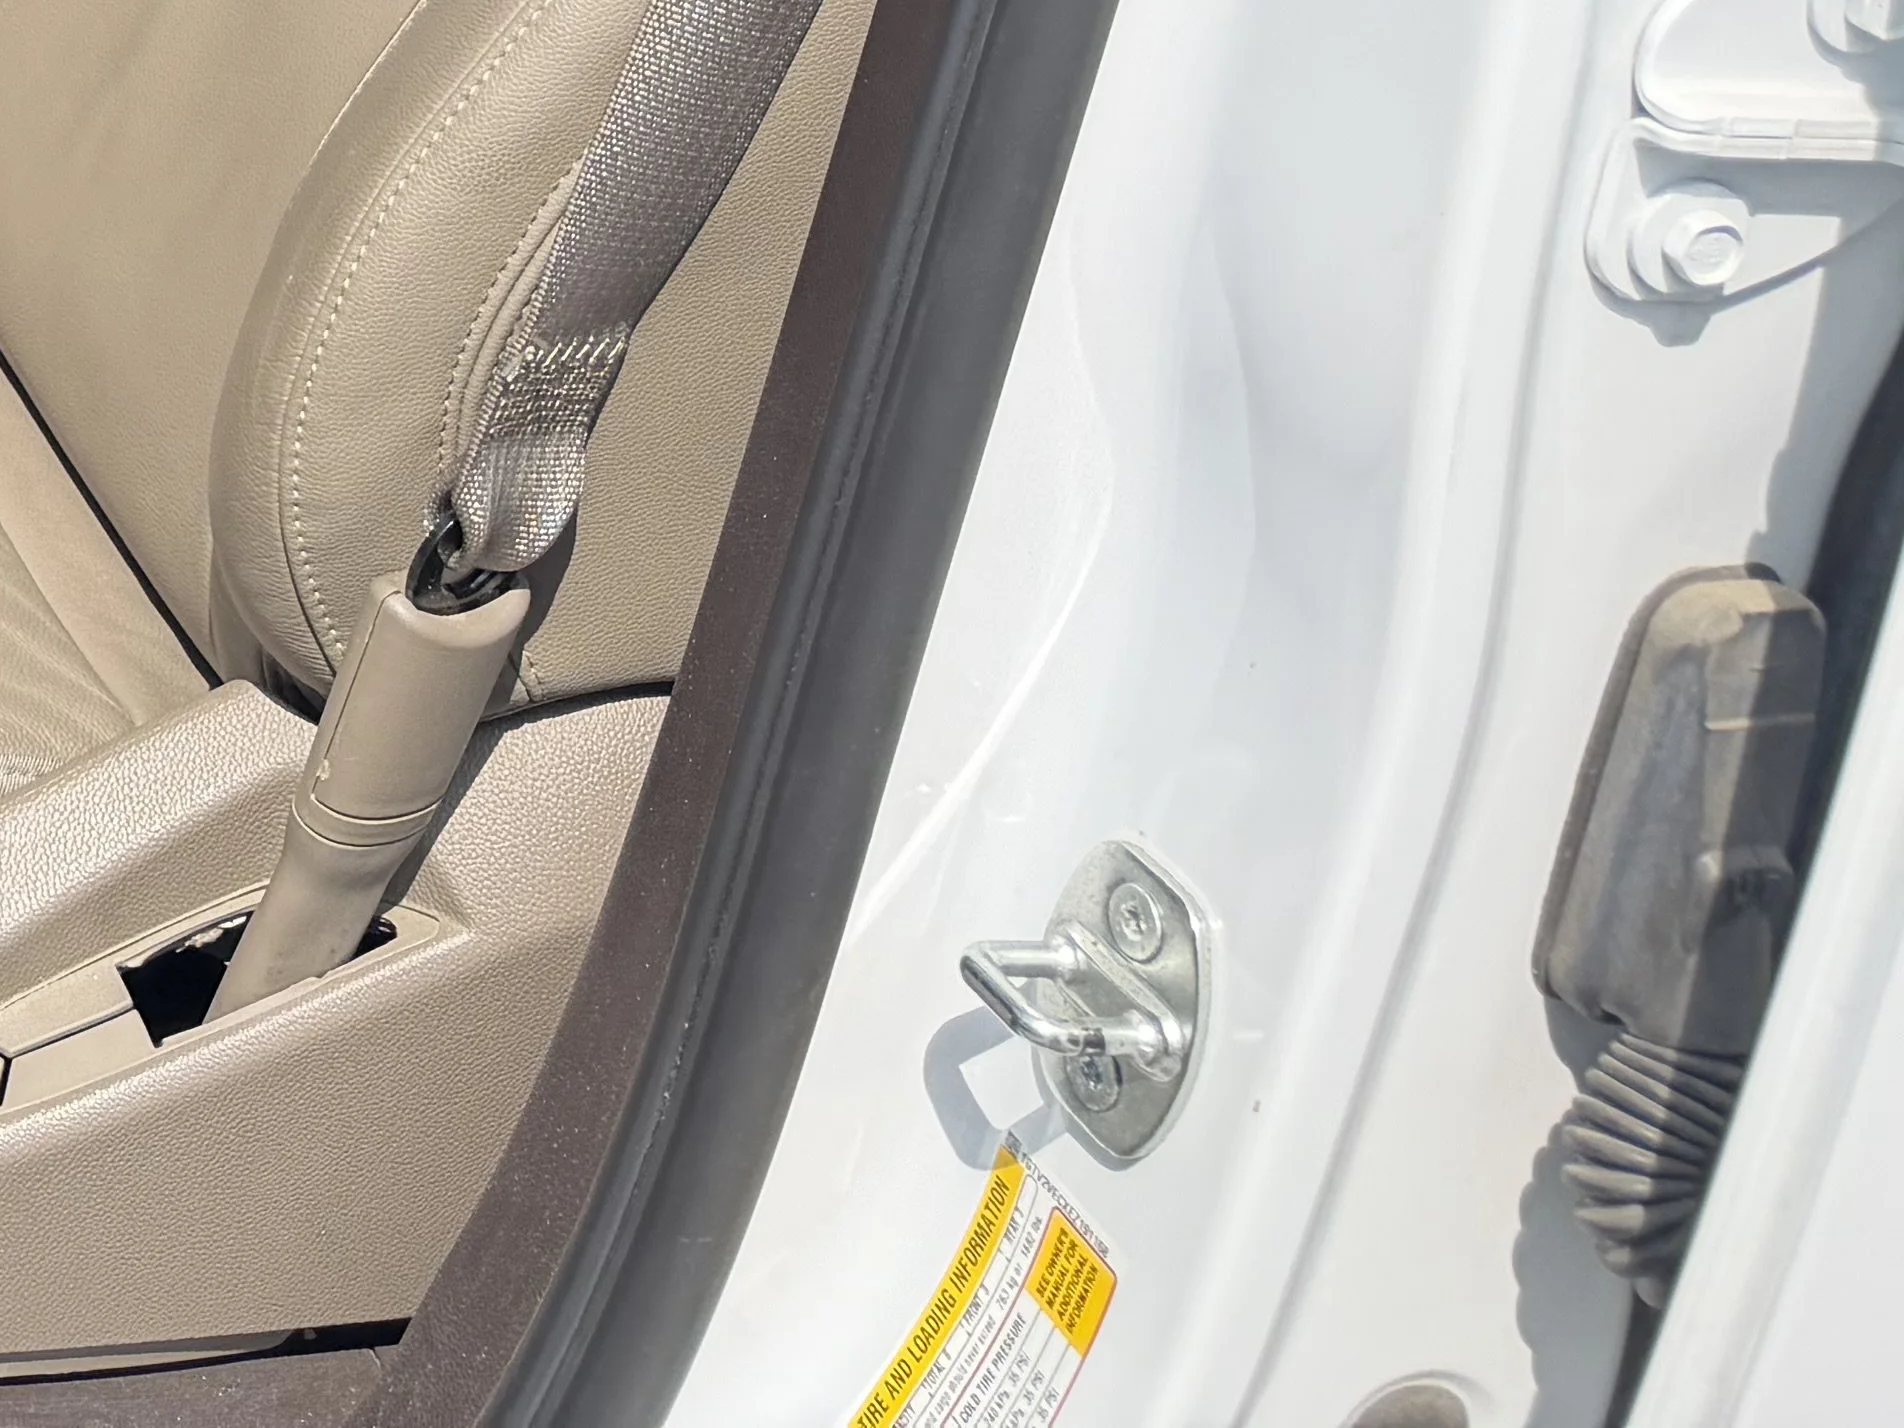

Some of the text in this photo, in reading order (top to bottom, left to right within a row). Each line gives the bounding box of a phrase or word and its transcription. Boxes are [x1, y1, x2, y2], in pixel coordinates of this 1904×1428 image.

[856, 1174, 1010, 1428] TIRE AND LOADING INFORMATION
[1045, 1239, 1080, 1310] MANUAL FOR
[1057, 1254, 1089, 1322] ADDITIONAL
[1065, 1262, 1099, 1336] INFORMATION
[959, 1312, 1026, 1424] COLD TIRE PRESSURE
